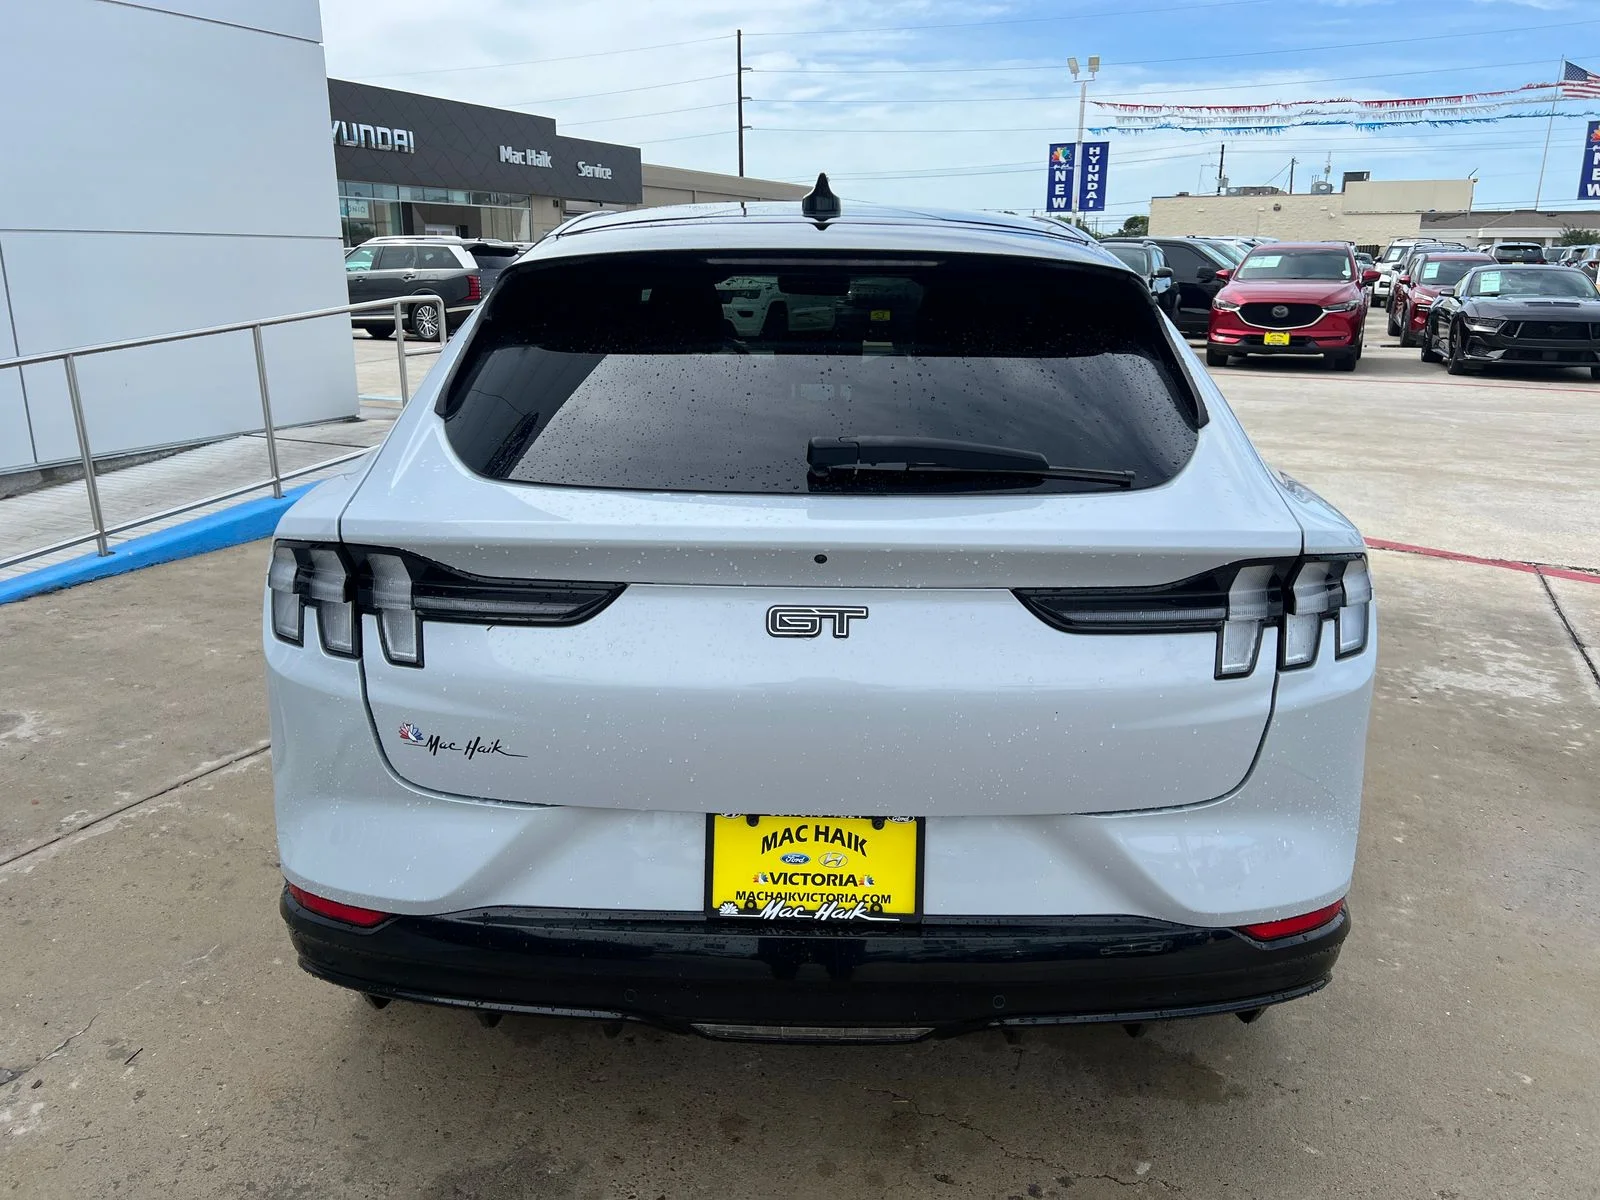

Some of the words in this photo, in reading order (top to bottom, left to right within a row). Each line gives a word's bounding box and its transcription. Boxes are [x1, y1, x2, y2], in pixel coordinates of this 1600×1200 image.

[499, 145, 526, 165] Mac
[526, 149, 552, 169] Haik
[577, 161, 612, 180] Service
[1086, 147, 1100, 208] HYUNDAI
[1052, 170, 1067, 209] NEW
[766, 605, 869, 638] GT
[424, 734, 463, 756] Mac
[464, 736, 528, 760] Haik
[761, 825, 809, 855] MAC
[814, 825, 868, 857] HAIK
[769, 872, 858, 887] VICTORIA
[759, 899, 812, 920] Mac
[813, 901, 900, 921] Haik
